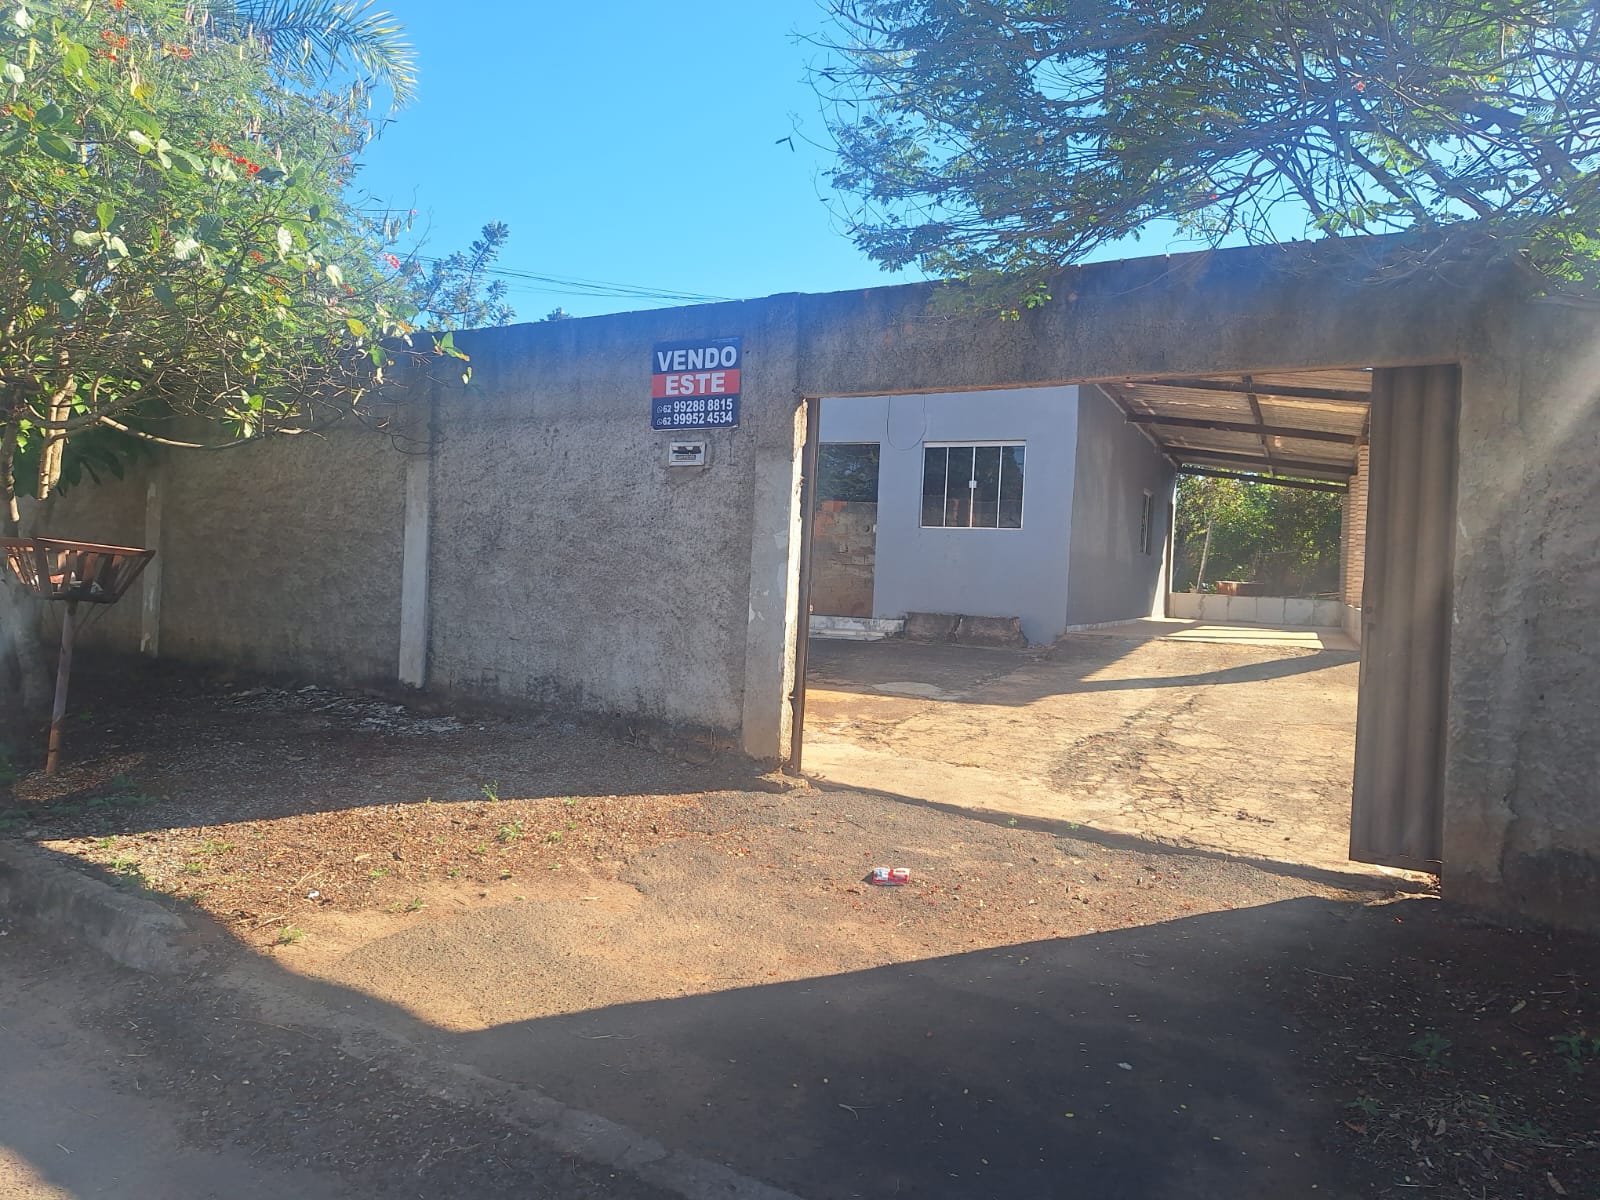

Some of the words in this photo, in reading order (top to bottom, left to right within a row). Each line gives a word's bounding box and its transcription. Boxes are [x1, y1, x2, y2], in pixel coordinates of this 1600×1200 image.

[657, 346, 737, 372] VENDO
[665, 373, 725, 395] ESTE
[663, 405, 672, 413] 62
[673, 400, 705, 412] 99288
[707, 398, 733, 411] 8815
[662, 417, 671, 425] 62
[673, 413, 705, 425] 99952
[707, 411, 733, 424] 4534
